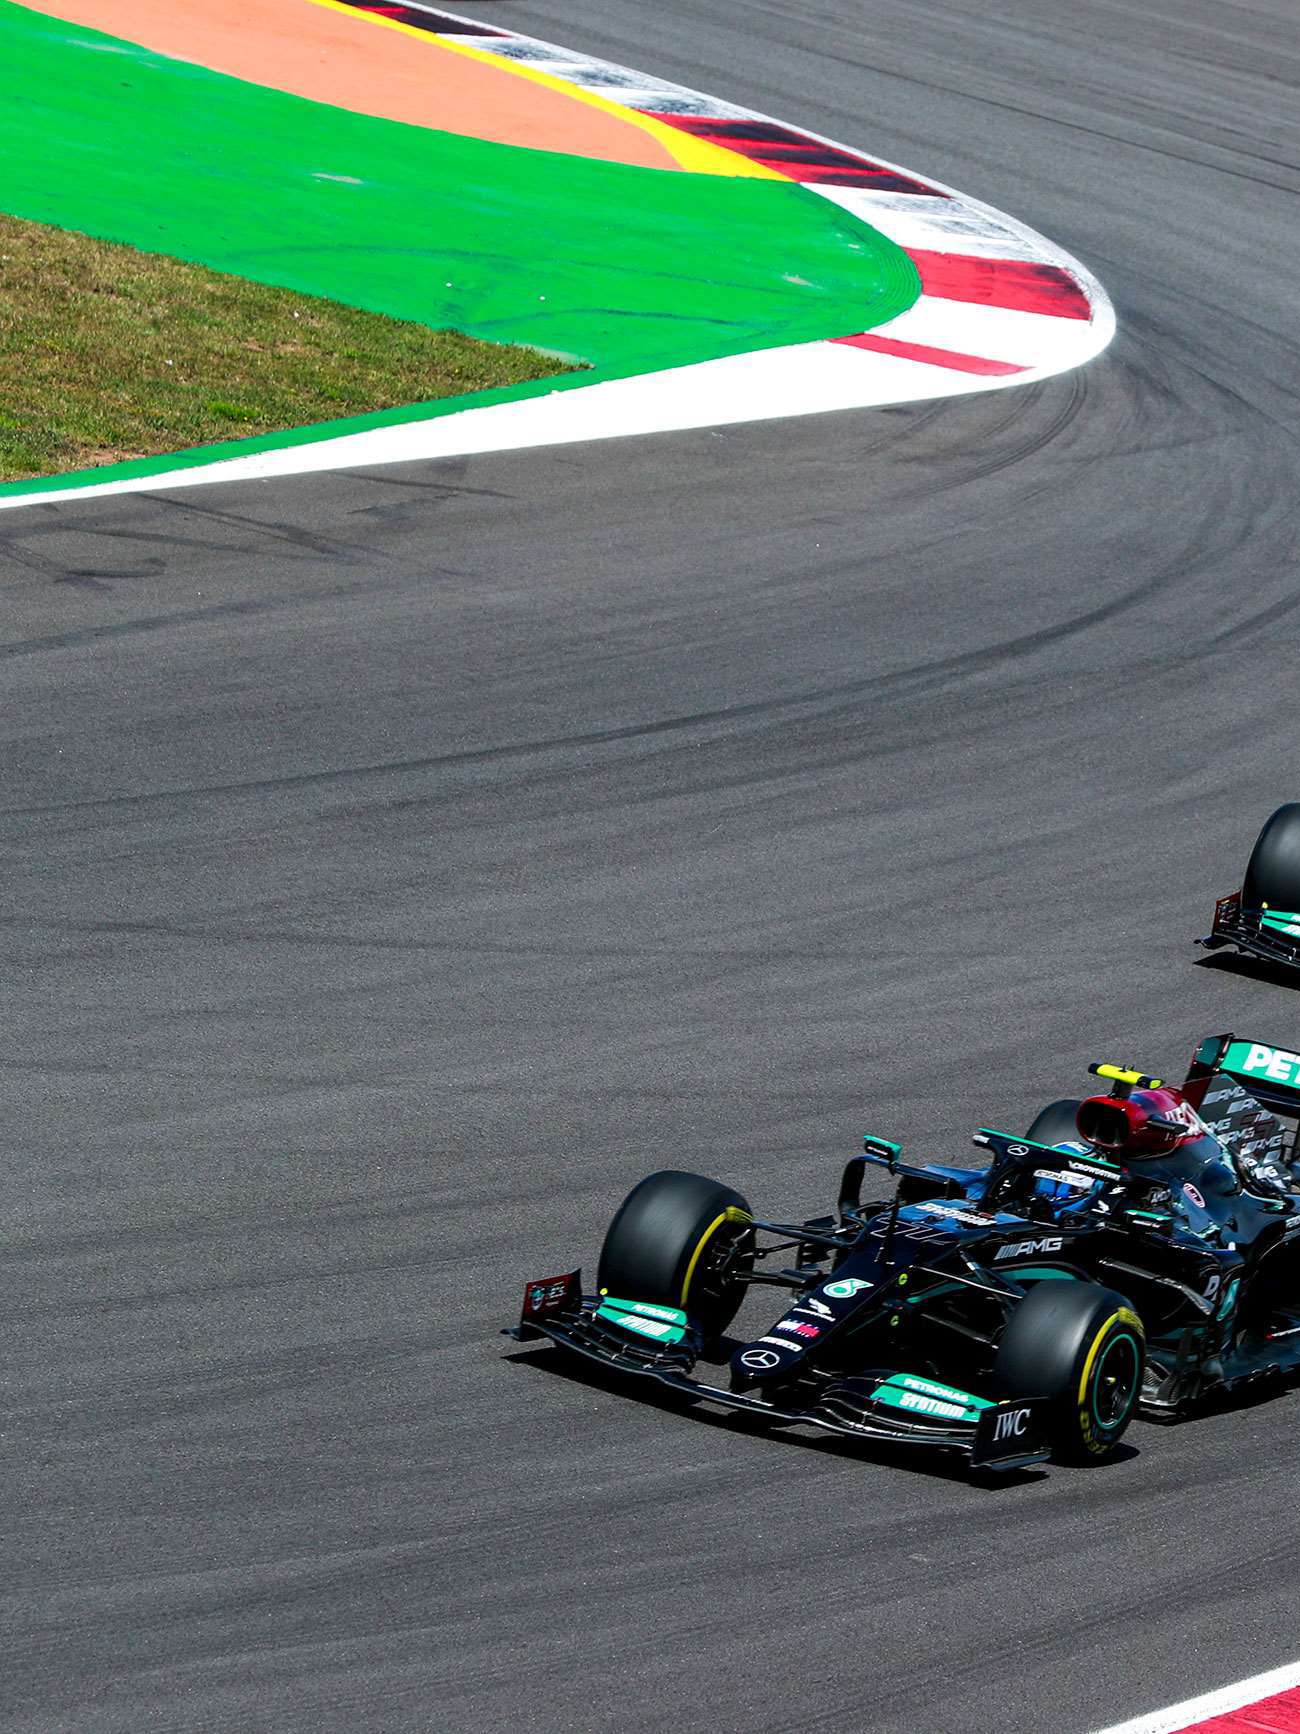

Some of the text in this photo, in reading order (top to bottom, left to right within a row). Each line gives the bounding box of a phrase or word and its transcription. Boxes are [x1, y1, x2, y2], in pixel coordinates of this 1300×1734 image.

[1016, 1237, 1064, 1256] AMG
[904, 1378, 970, 1402] PETRONAS
[992, 1408, 1031, 1441] IWC
